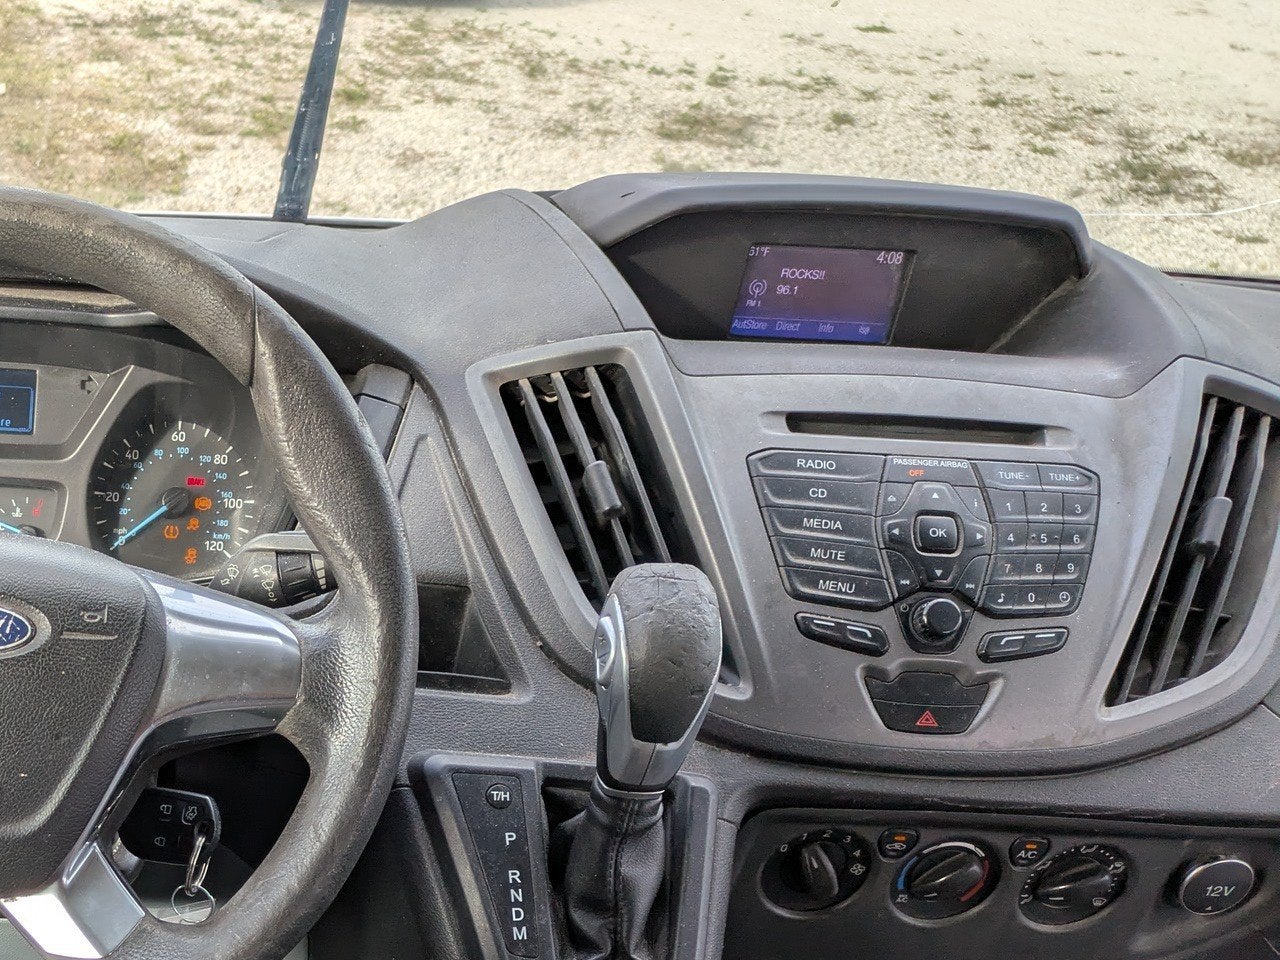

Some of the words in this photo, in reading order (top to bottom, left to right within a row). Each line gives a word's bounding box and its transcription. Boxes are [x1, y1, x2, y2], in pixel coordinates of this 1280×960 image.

[876, 251, 904, 265] 4:08
[781, 268, 826, 280] ROCKS!!
[776, 284, 798, 295] 96.1
[775, 321, 801, 332] Direct
[171, 431, 186, 442] 60
[125, 449, 140, 460] 40
[213, 454, 228, 465] 80
[796, 458, 836, 471] RADIO
[893, 458, 939, 468] PASSENGER
[939, 460, 968, 470] AIRBAG
[909, 469, 925, 478] OFF
[105, 492, 120, 502] 20
[809, 488, 828, 498] CD
[223, 498, 243, 509] 100
[1040, 502, 1048, 513] 2
[1074, 503, 1082, 514] 3
[803, 517, 843, 530] MEDIA
[213, 532, 231, 540] km/h
[929, 527, 947, 538] OK
[1007, 533, 1015, 543] 4
[1040, 533, 1048, 544] 5
[1073, 534, 1081, 544] 6
[204, 541, 224, 552] 120
[810, 548, 846, 562] MUTE
[1004, 564, 1012, 574] 7
[1035, 562, 1043, 573] 8
[1067, 563, 1075, 574] 9
[818, 580, 856, 594] MENU
[1028, 593, 1035, 604] 0
[491, 790, 510, 802] T/H
[505, 832, 516, 846] P
[802, 833, 808, 841] 1
[823, 830, 833, 838] 2
[842, 835, 852, 844] 3
[853, 850, 861, 858] 4
[508, 870, 522, 884] R
[510, 888, 523, 902] N
[1205, 885, 1236, 898] 12V
[512, 908, 525, 922] D
[513, 926, 528, 940] M
